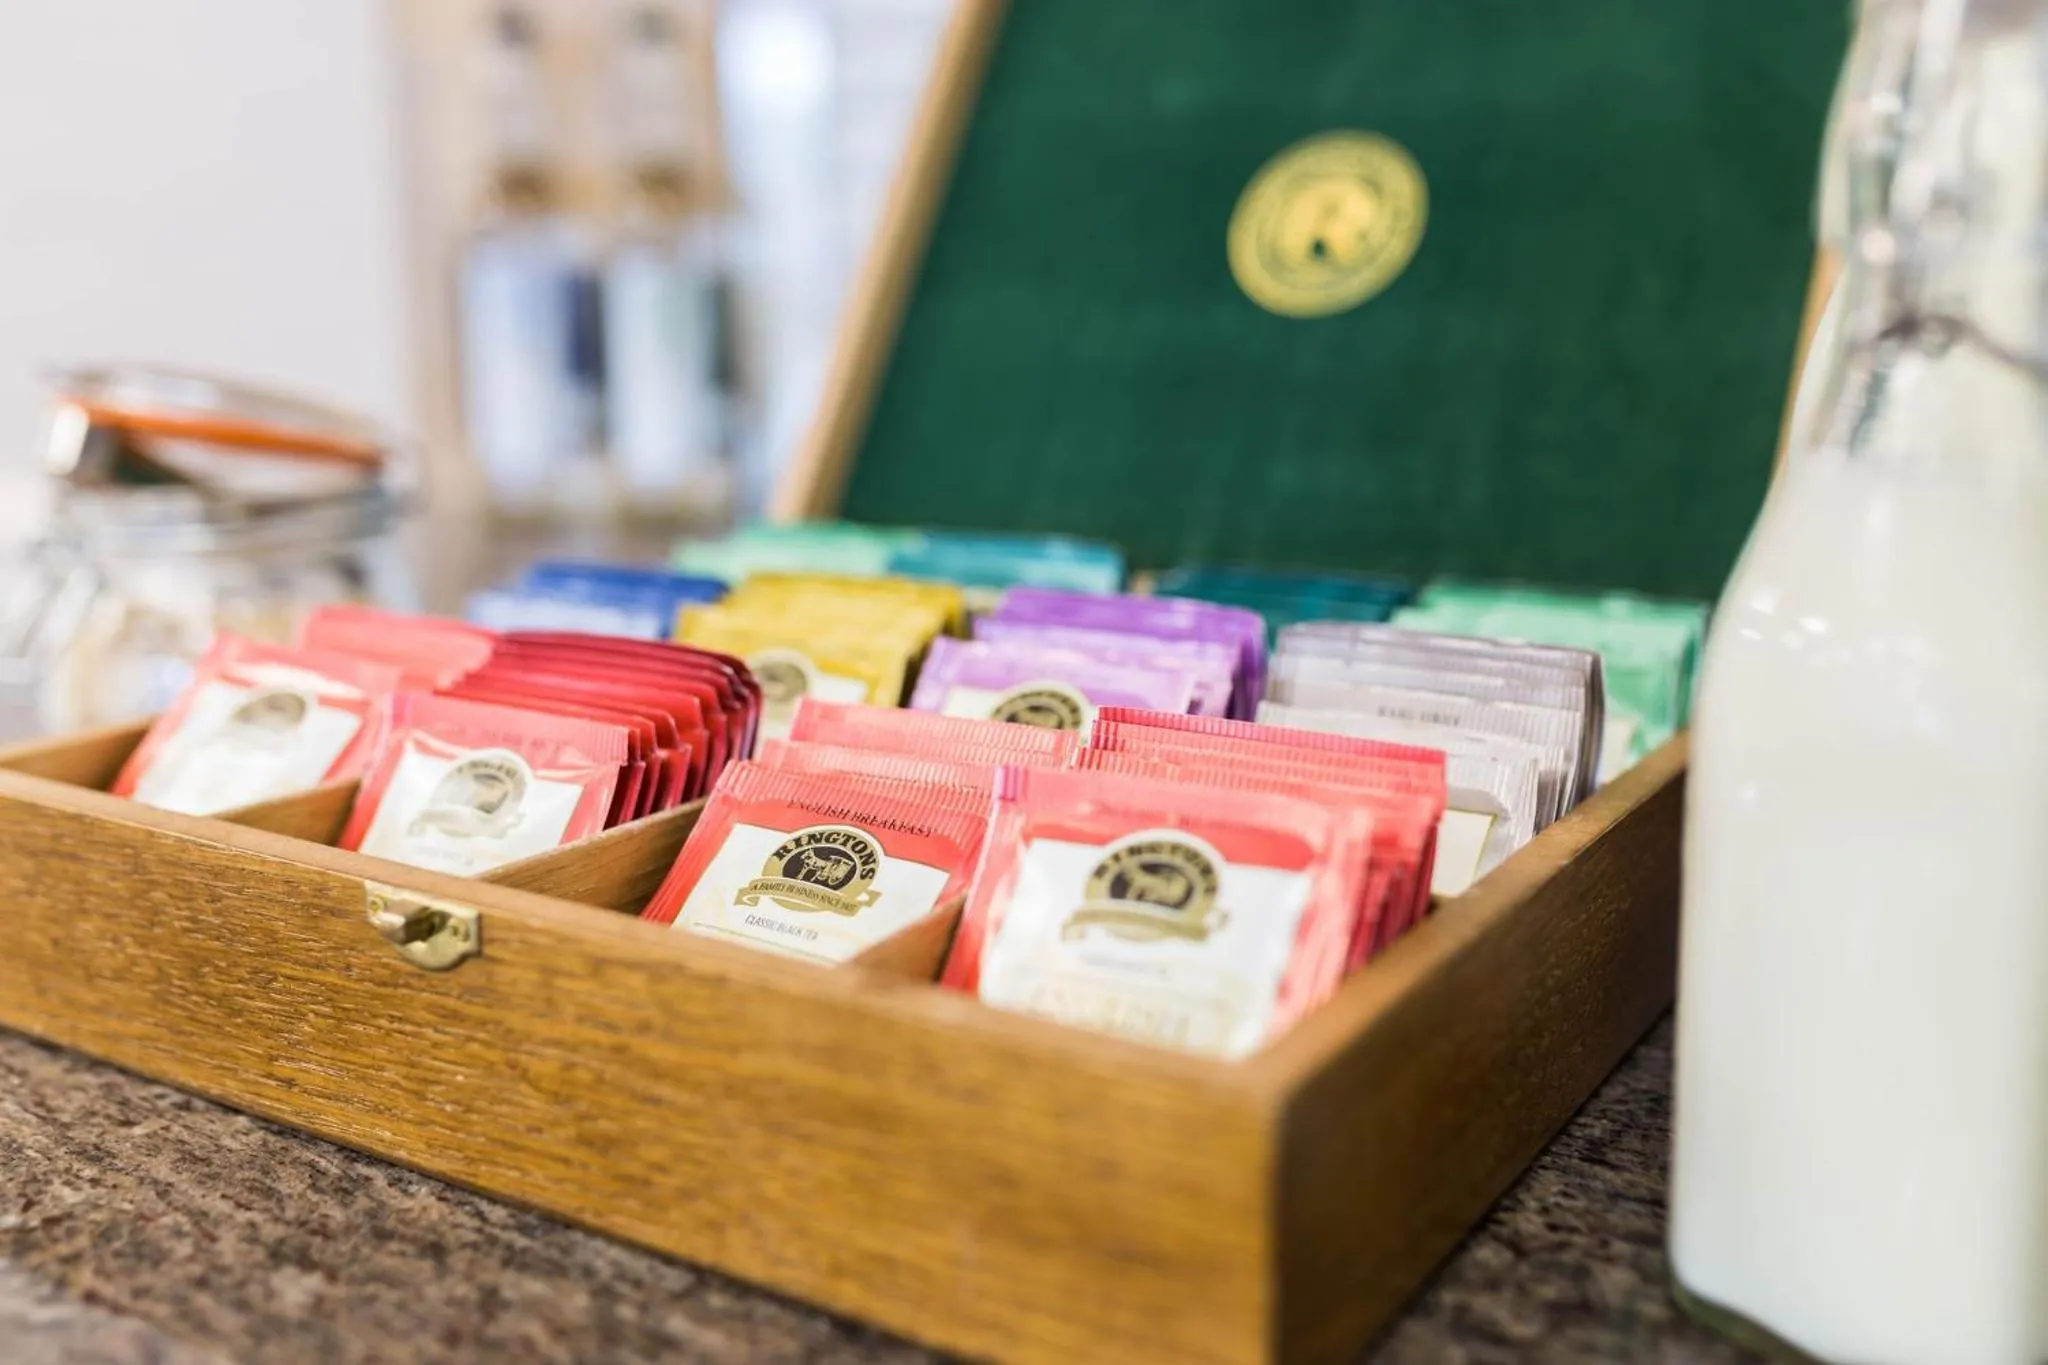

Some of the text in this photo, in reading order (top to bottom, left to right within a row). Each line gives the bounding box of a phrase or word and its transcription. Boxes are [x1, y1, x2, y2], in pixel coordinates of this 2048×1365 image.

[787, 799, 934, 838] ENGLISH BREAKFAST
[772, 831, 876, 880] RINGTONS
[744, 914, 776, 930] CLASSIC
